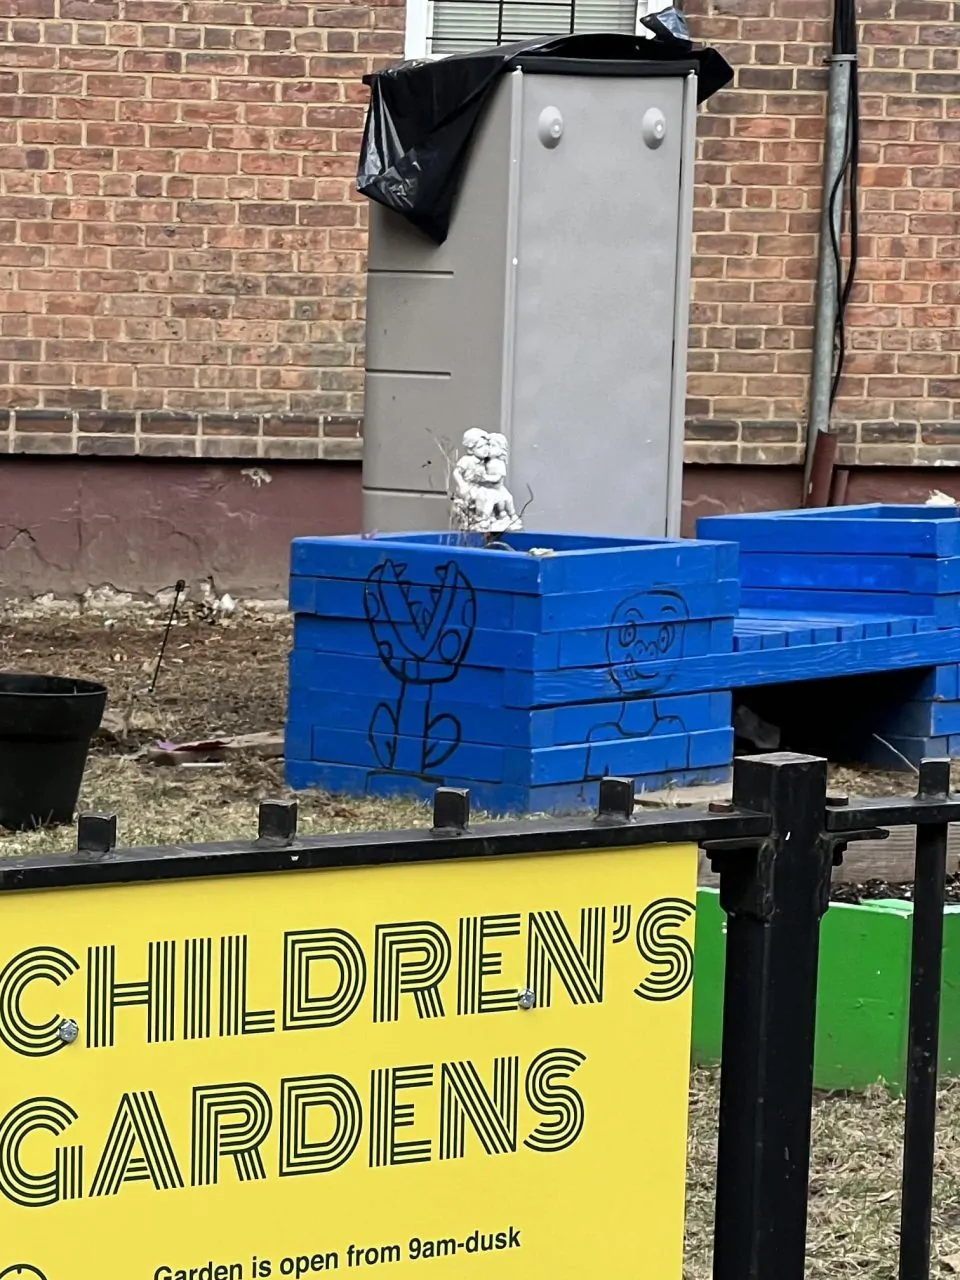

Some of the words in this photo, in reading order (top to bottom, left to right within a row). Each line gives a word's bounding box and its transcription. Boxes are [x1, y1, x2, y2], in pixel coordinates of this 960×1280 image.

[252, 1255, 272, 1279] is
[279, 1252, 339, 1280] open
[346, 1244, 401, 1267] from
[408, 1226, 521, 1260] 9am-dusk
